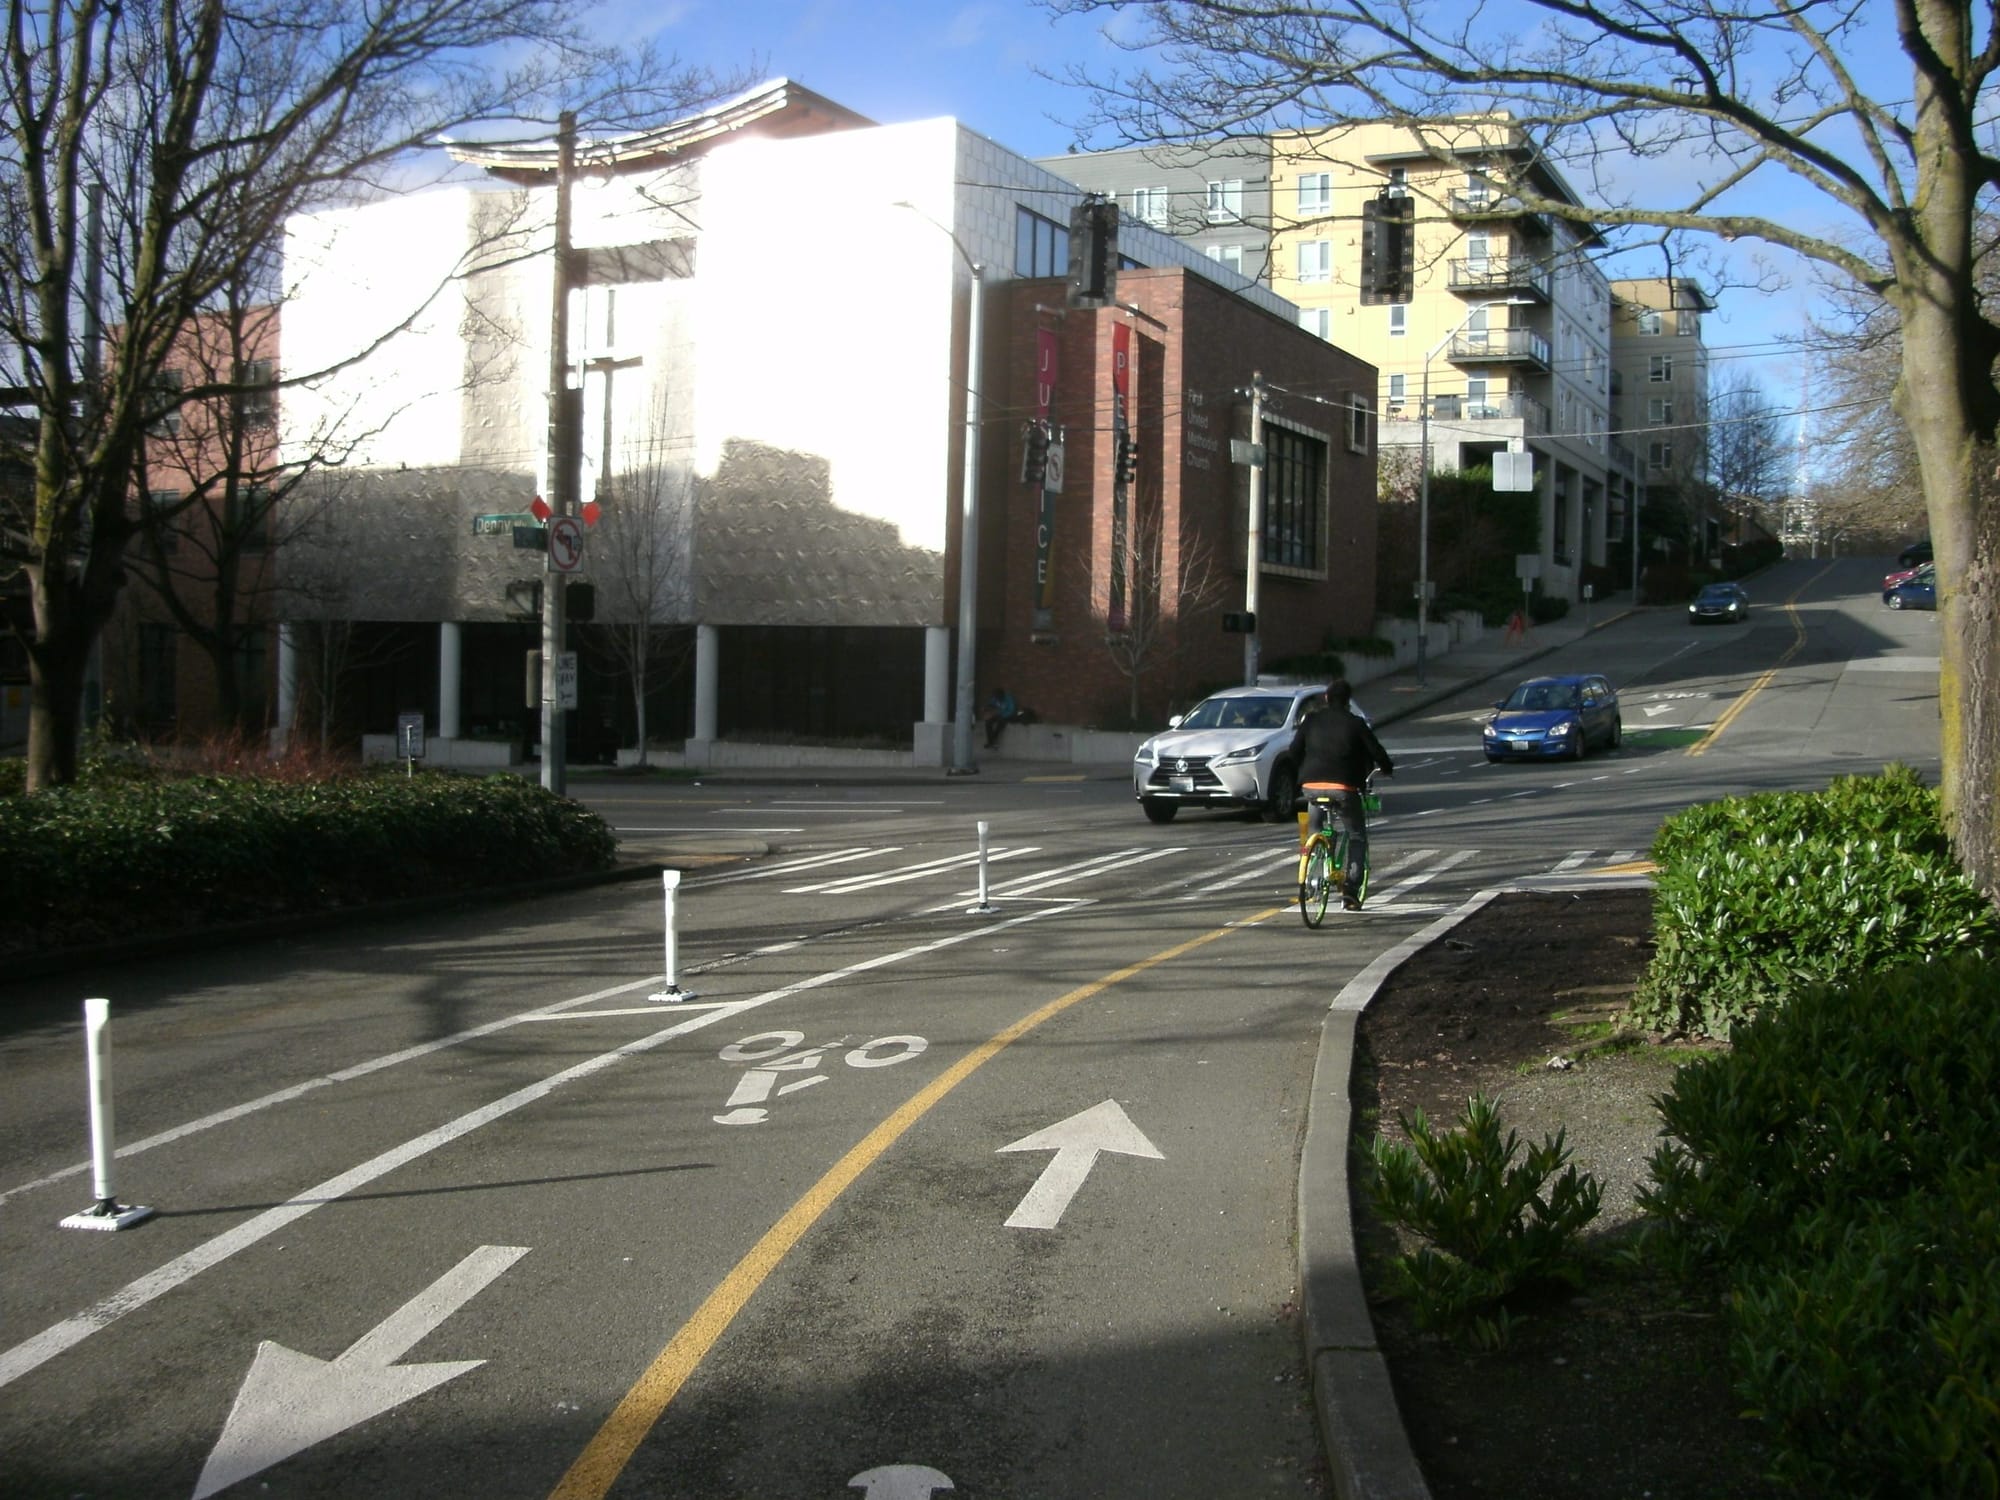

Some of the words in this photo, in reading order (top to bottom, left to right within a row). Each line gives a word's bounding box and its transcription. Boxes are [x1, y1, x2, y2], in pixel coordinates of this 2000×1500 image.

[1188, 389, 1203, 406] First
[1187, 408, 1209, 429] United
[1037, 349, 1050, 584] JUSICE
[477, 518, 511, 533] Denny
